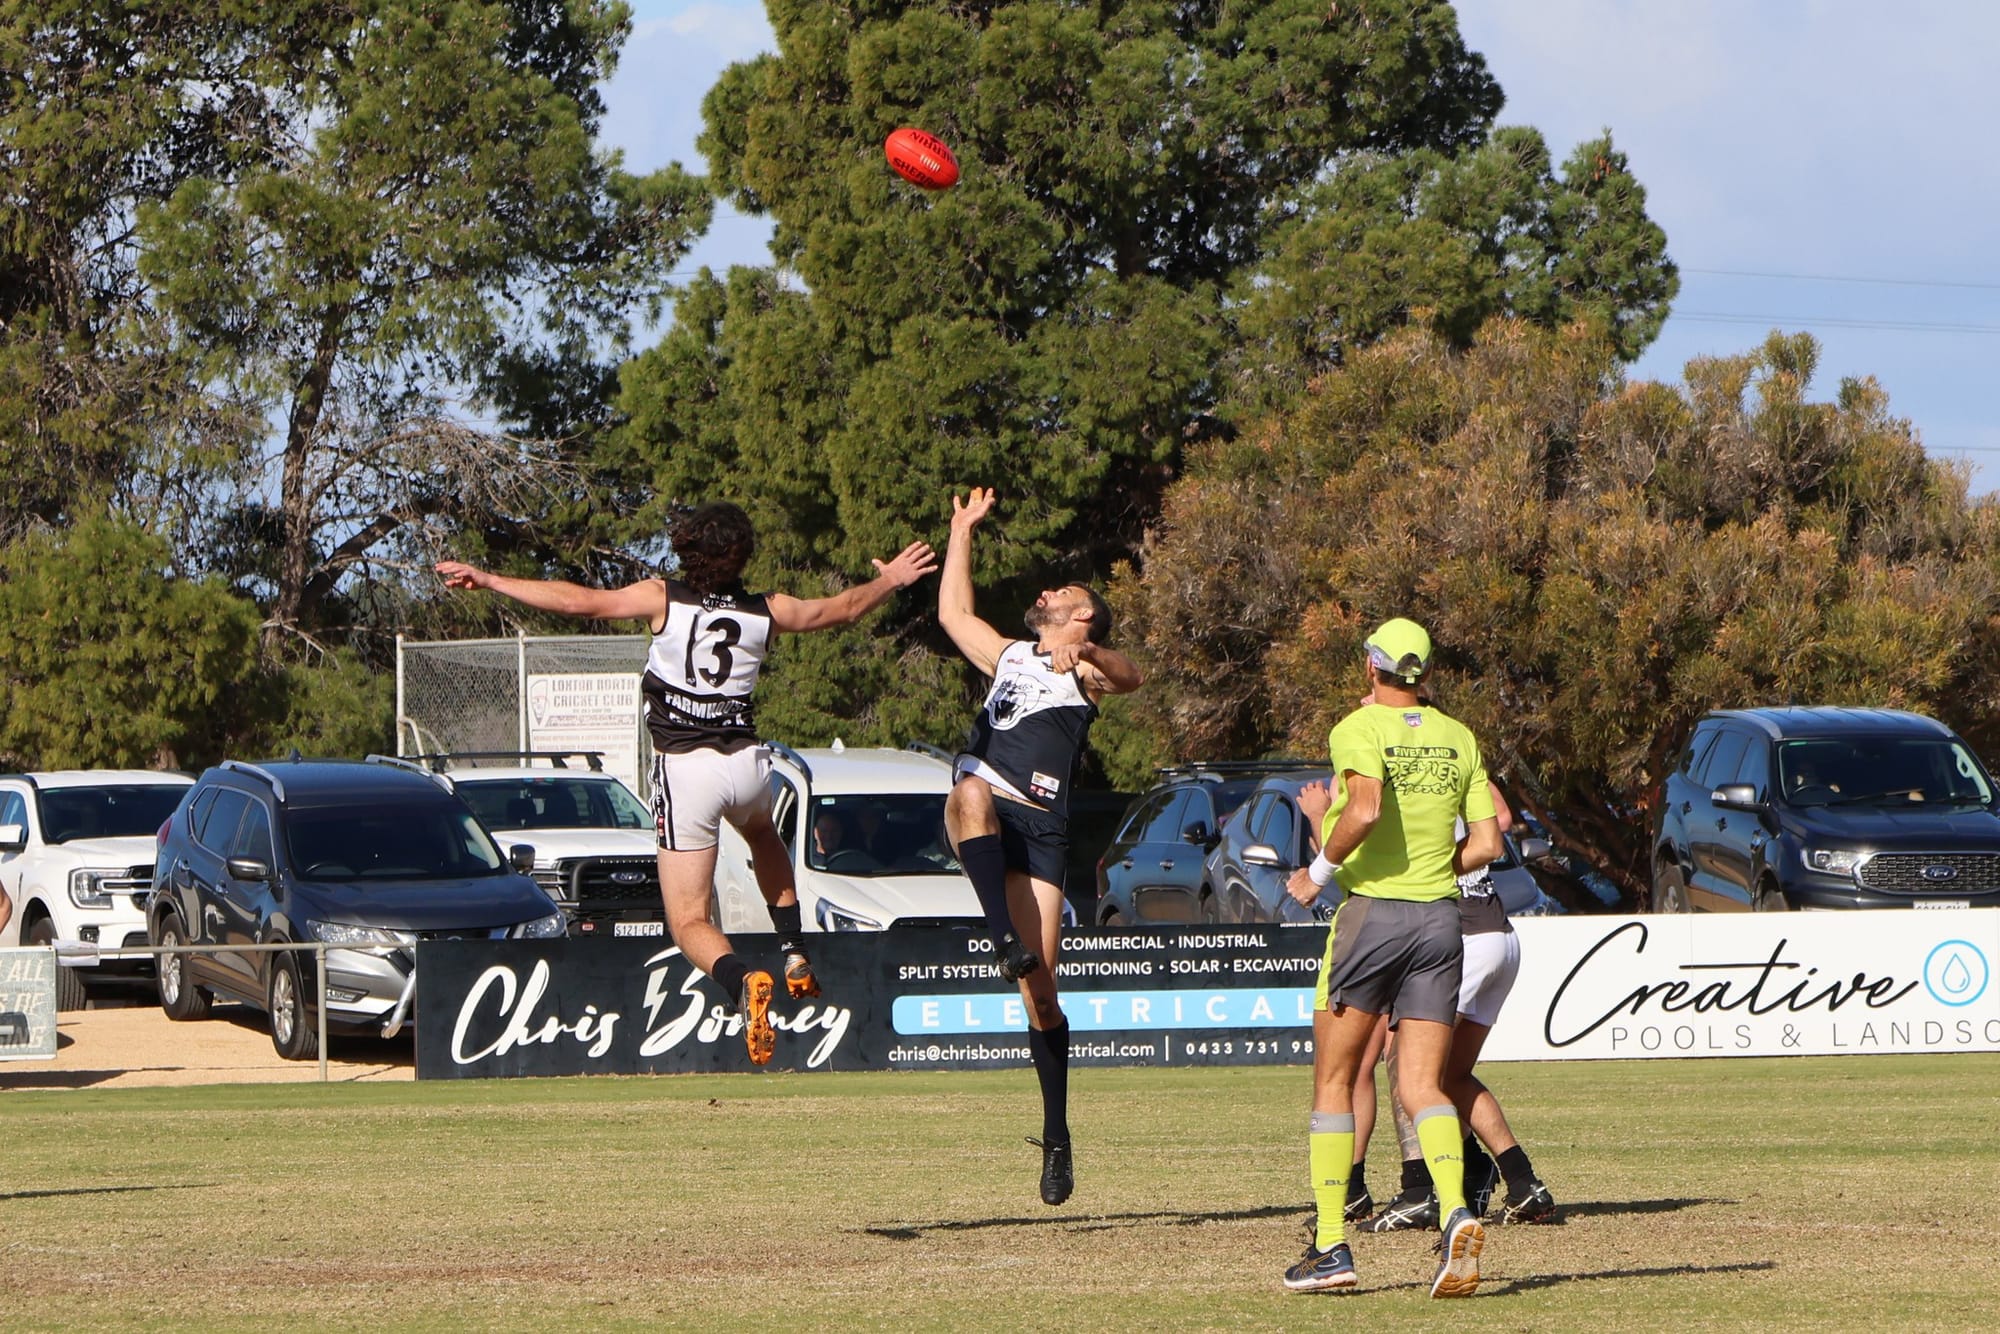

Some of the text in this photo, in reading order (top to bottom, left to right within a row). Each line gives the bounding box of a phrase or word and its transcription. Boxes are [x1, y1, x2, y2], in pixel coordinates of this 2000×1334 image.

[893, 156, 937, 187] SHERR
[685, 614, 742, 689] 13
[552, 678, 635, 692] LOXTON NORTH
[553, 694, 633, 708] CRICKET CLUB
[1393, 747, 1451, 758] RIVERLAND
[1061, 934, 1268, 951] COMMERCIAL INDUSTRIAL
[899, 966, 938, 980] SPLIT
[1055, 962, 1152, 977] NDITIONING
[1170, 960, 1220, 974] SOLAR
[1544, 921, 1920, 1048] Creative
[451, 959, 621, 1066] Chris
[921, 994, 1314, 1028] ELETRICAL
[1612, 1019, 2000, 1051] POOLS & LANDSC
[888, 1040, 1314, 1063] chris@chrisbonnectrical.com 0433 731 98
